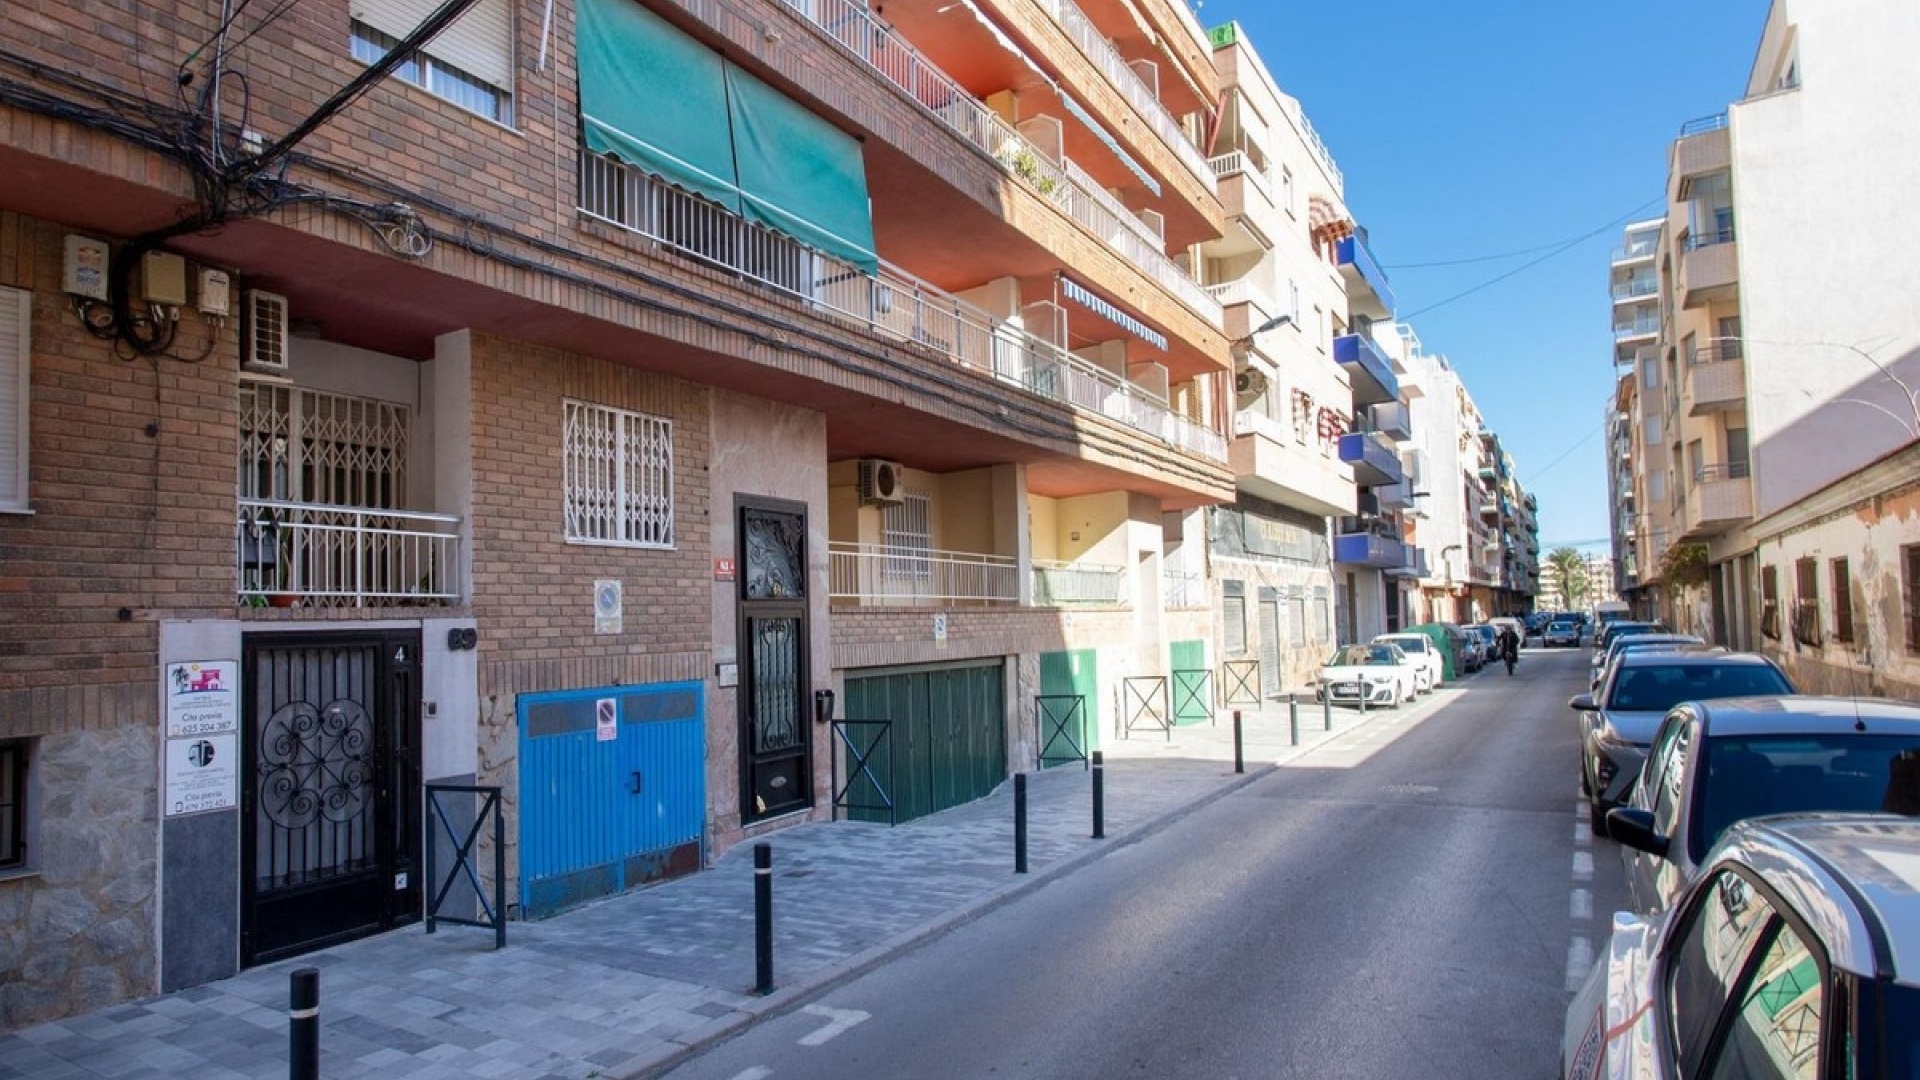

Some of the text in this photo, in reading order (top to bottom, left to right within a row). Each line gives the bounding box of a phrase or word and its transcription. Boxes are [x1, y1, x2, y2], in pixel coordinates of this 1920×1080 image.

[394, 646, 405, 662] 4
[182, 711, 223, 722] Cita previa
[185, 794, 199, 802] Cita
